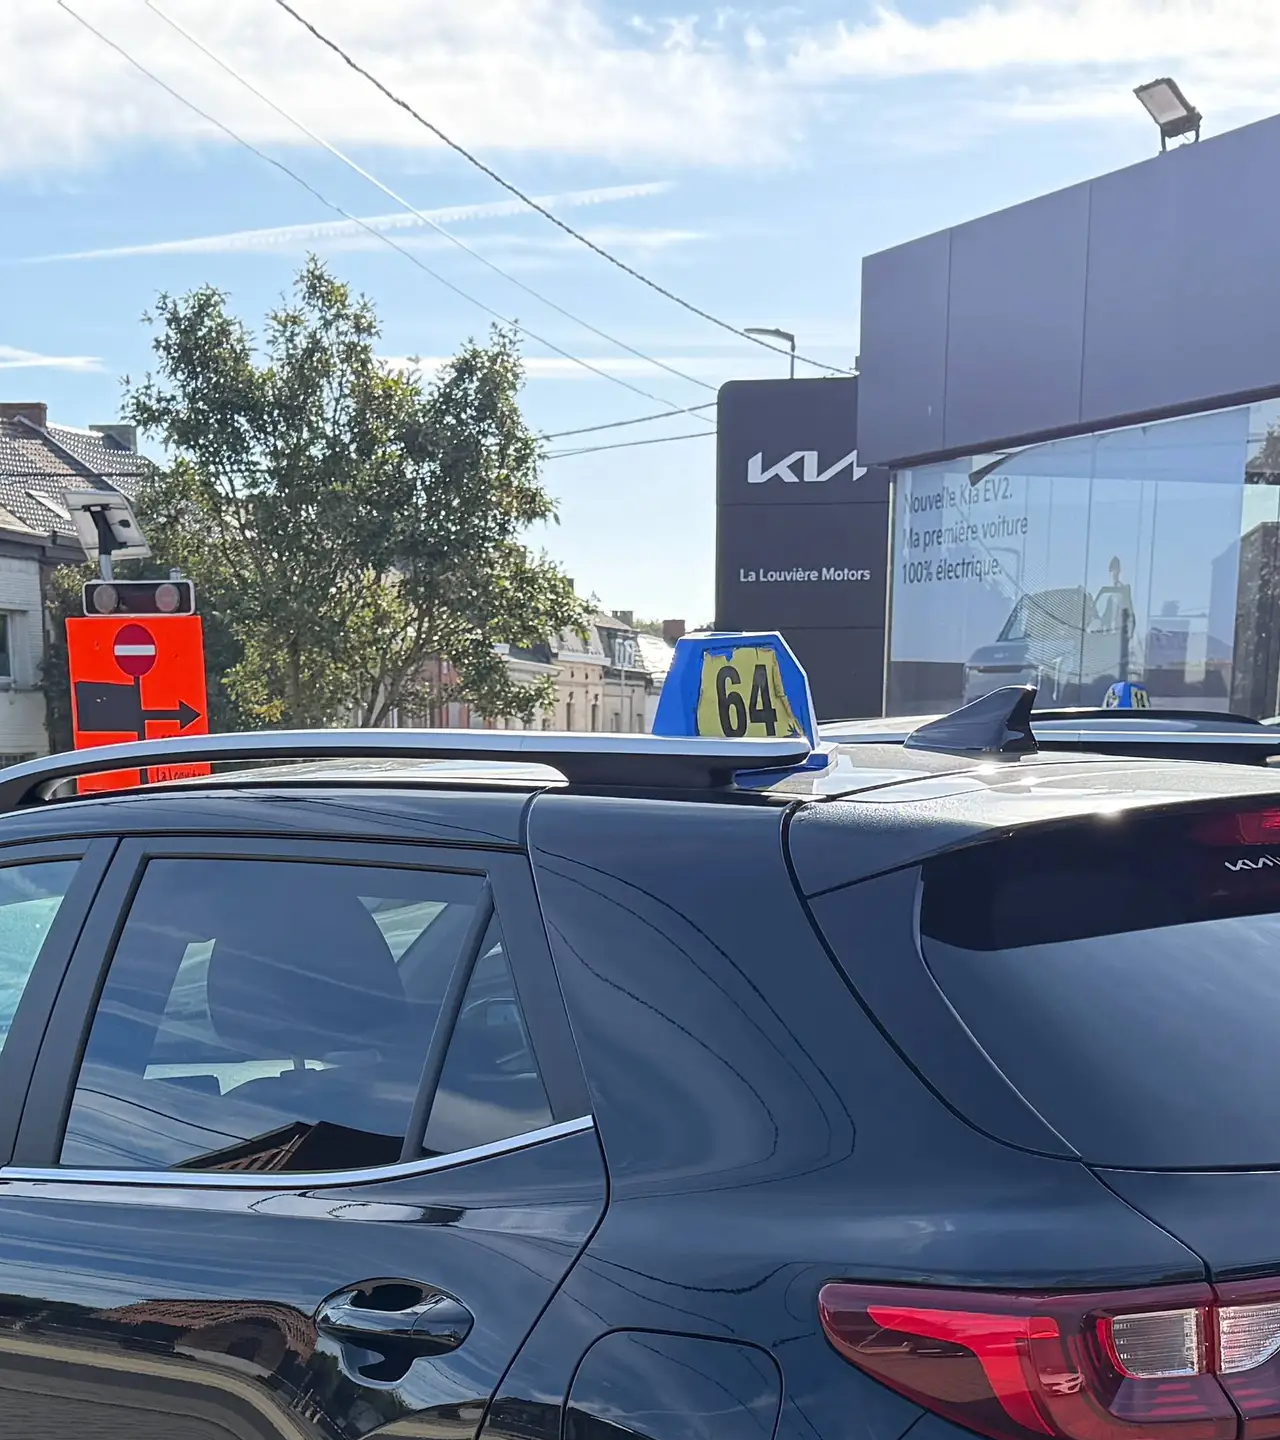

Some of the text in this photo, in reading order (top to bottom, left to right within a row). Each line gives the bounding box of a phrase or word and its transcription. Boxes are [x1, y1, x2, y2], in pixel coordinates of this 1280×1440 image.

[747, 449, 868, 483] KIA
[904, 477, 1013, 514] Nouvelle Kia EV2.
[923, 520, 978, 553] première
[981, 515, 1029, 540] voiture
[739, 567, 871, 581] La Louvière Motors
[902, 554, 1002, 584] 100% électrique.
[716, 664, 778, 738] 64
